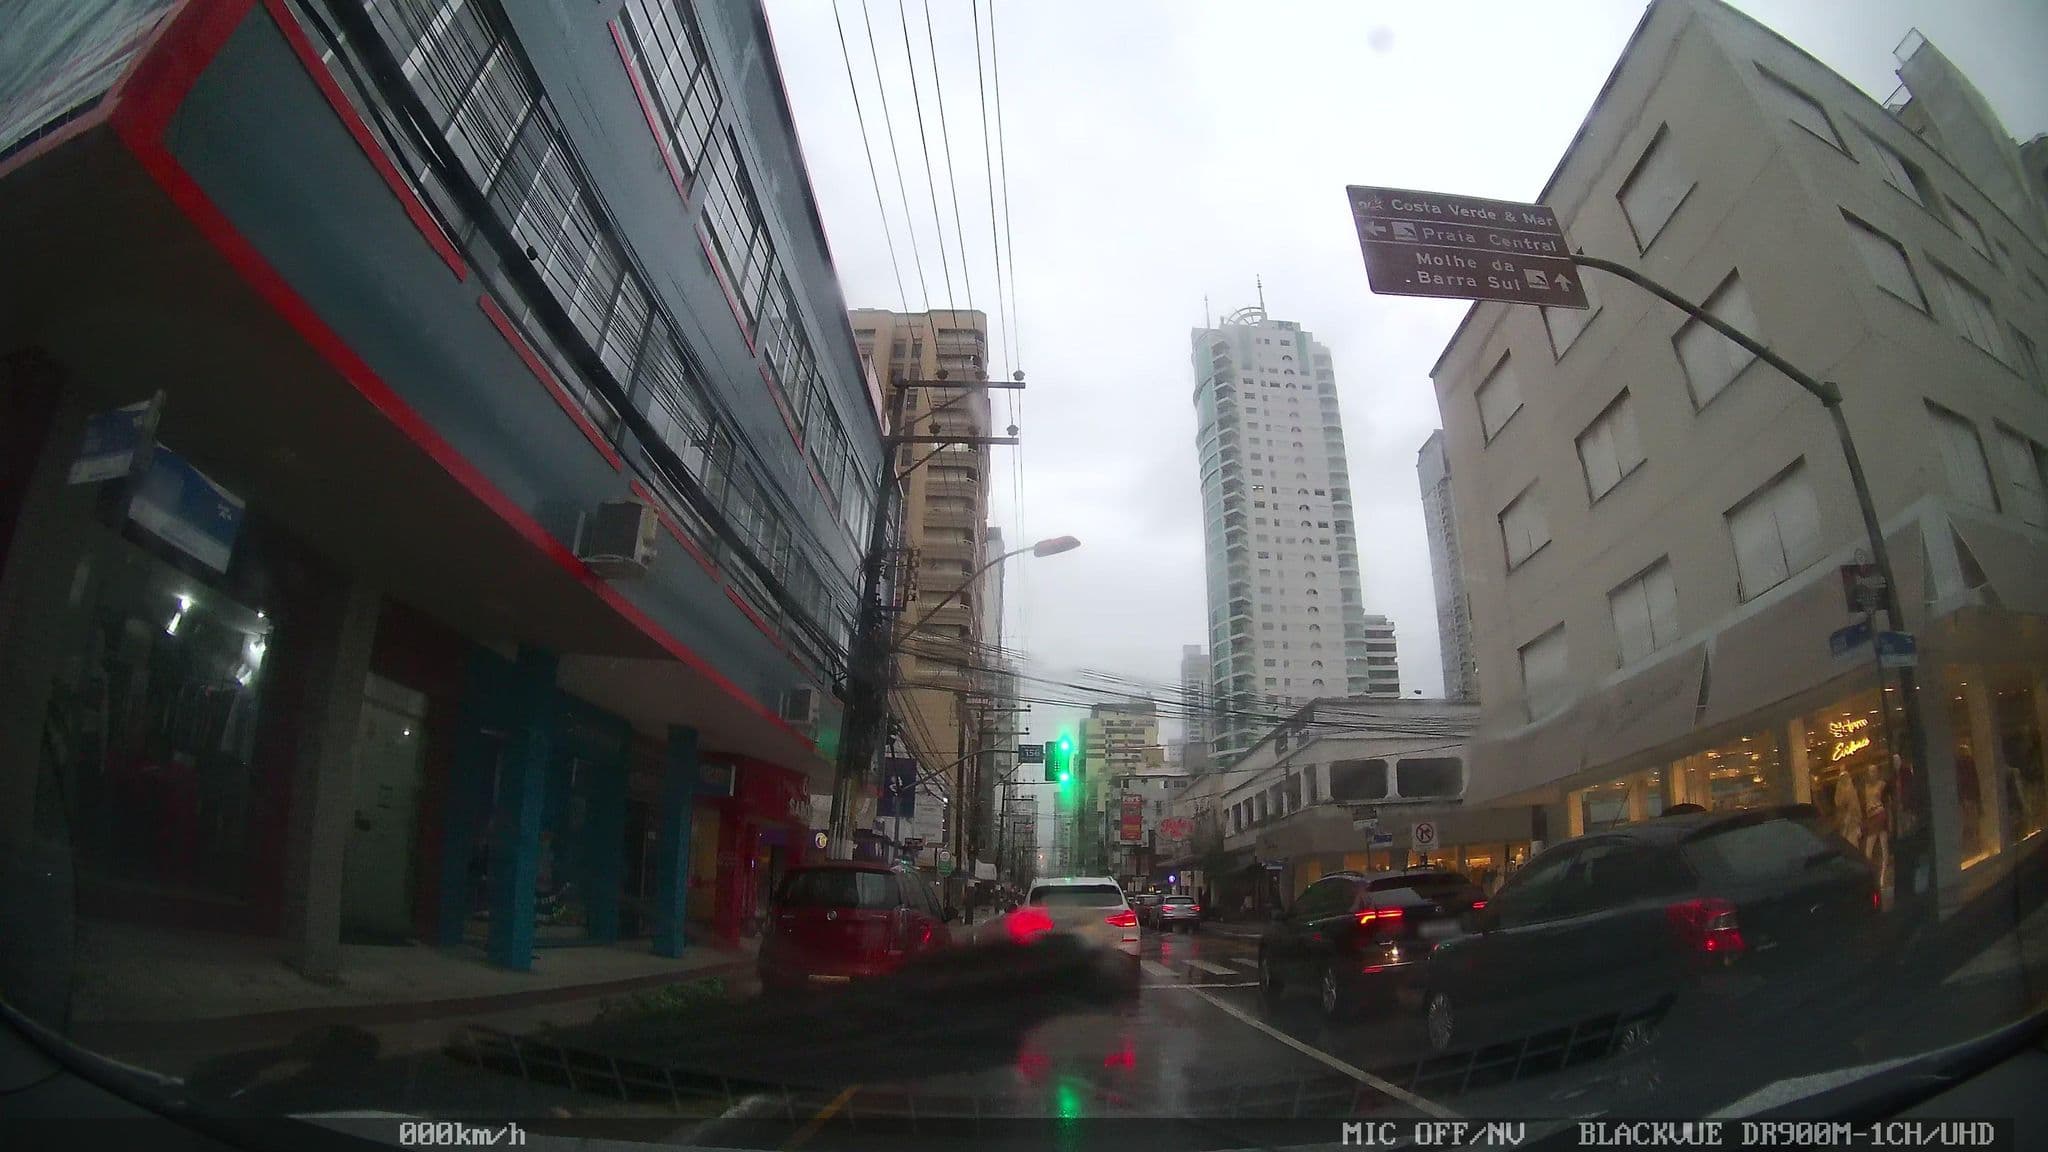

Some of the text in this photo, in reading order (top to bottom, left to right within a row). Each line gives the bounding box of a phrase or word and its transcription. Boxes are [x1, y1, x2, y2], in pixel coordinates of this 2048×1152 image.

[1391, 199, 1553, 227] Costa Verde & Mar
[1422, 227, 1557, 252] Praia Central
[1416, 253, 1515, 272] Molhe da
[1417, 270, 1521, 291] Barra Sul
